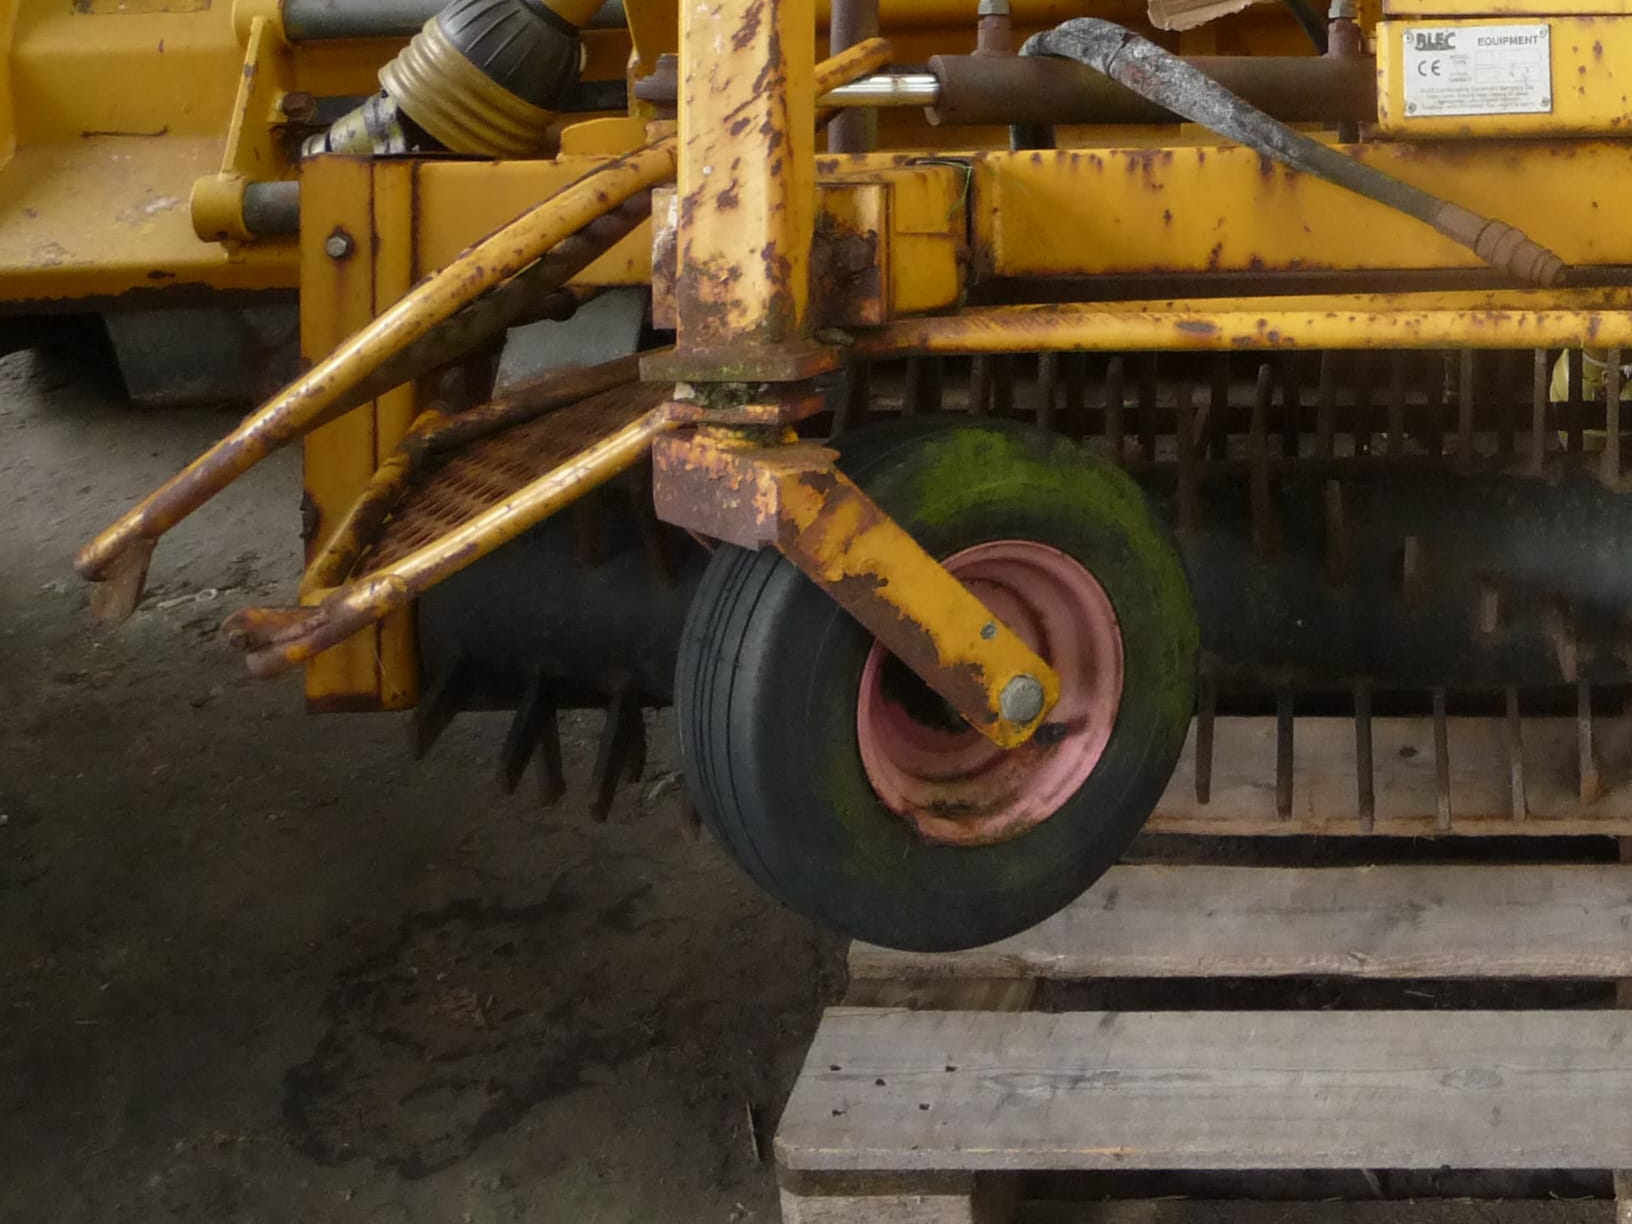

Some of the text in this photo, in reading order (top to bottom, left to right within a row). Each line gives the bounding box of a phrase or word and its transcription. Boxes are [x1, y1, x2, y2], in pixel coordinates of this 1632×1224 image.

[1415, 31, 1539, 51] BLEC EQUIPMENT
[1417, 60, 1441, 77] CE
